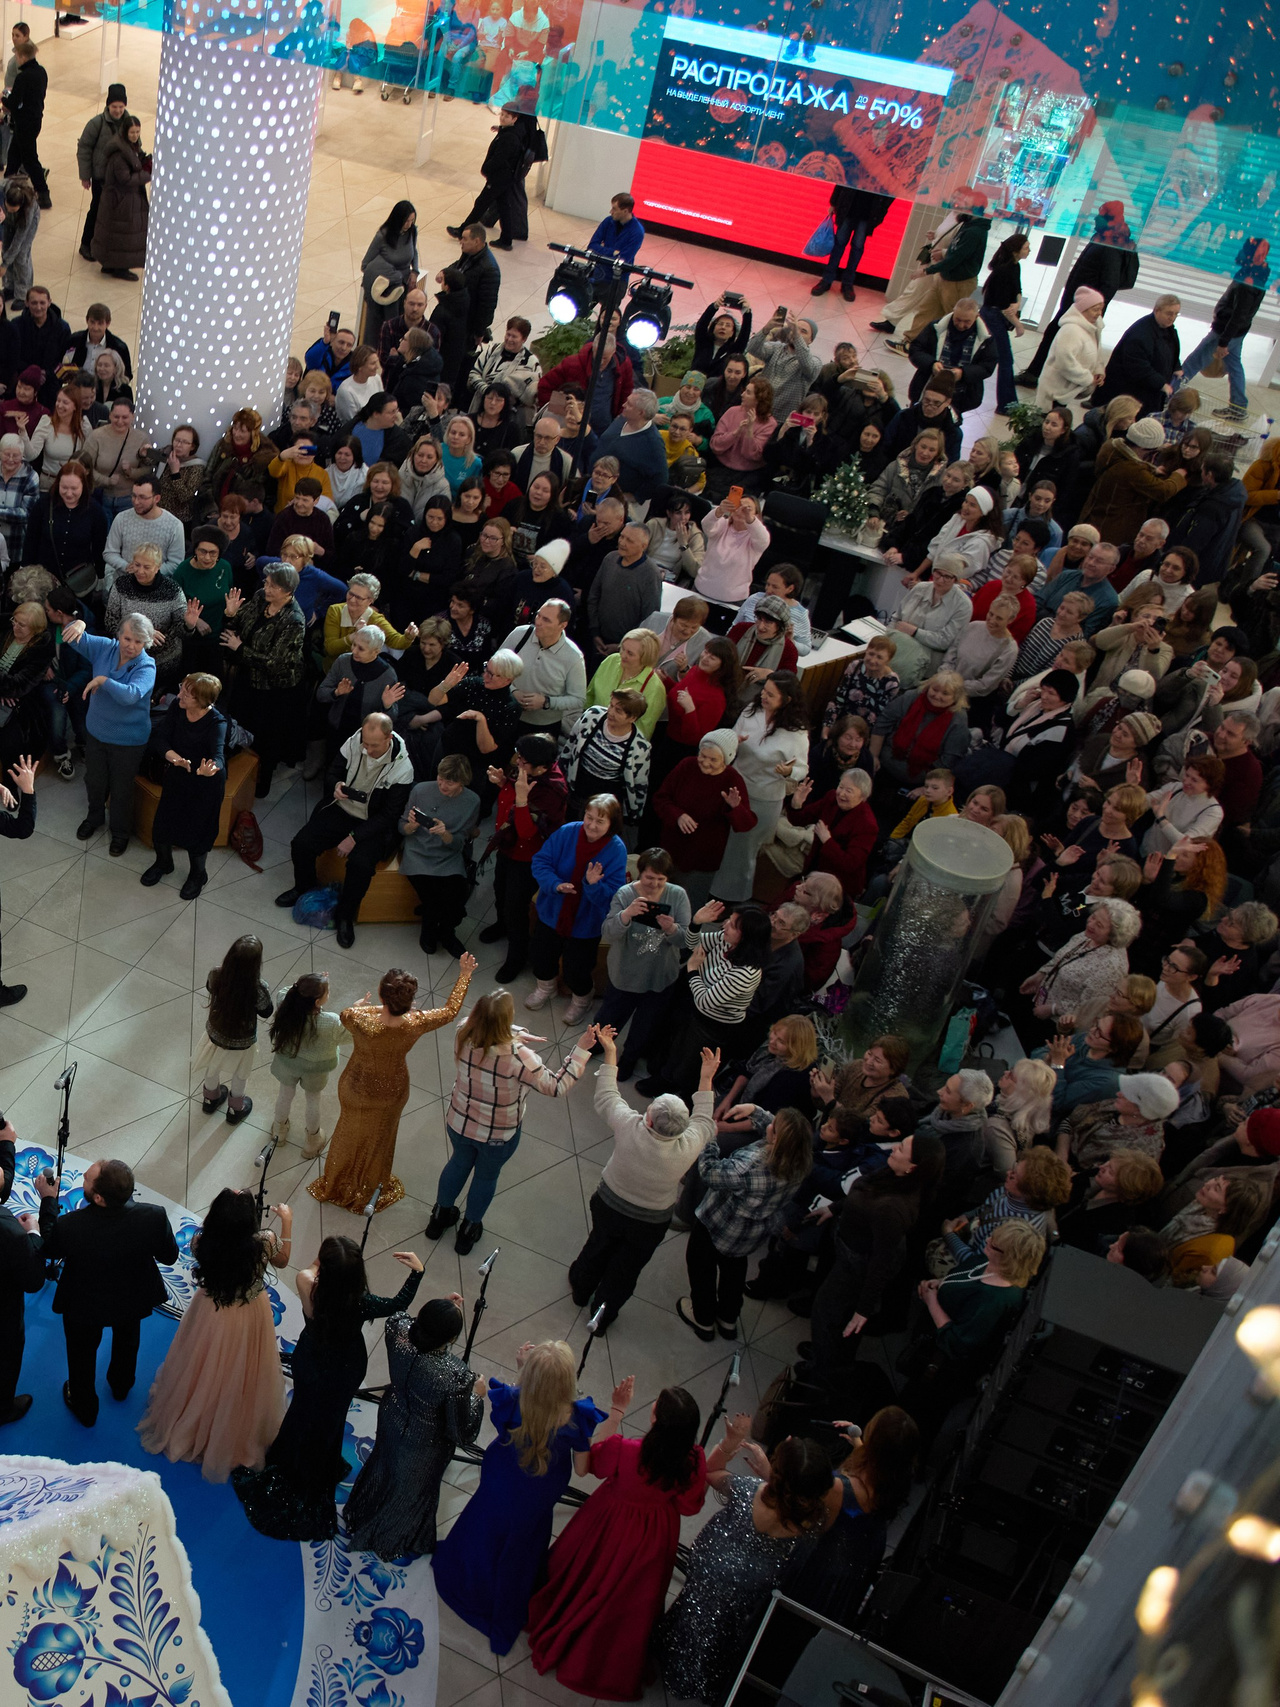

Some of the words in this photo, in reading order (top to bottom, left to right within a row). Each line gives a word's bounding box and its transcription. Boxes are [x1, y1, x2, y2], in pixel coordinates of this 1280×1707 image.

[666, 87, 677, 98] НА
[677, 89, 729, 109] ВЫДЕЛЕННЫЙ
[670, 55, 849, 115] РАСПРОДАЖА
